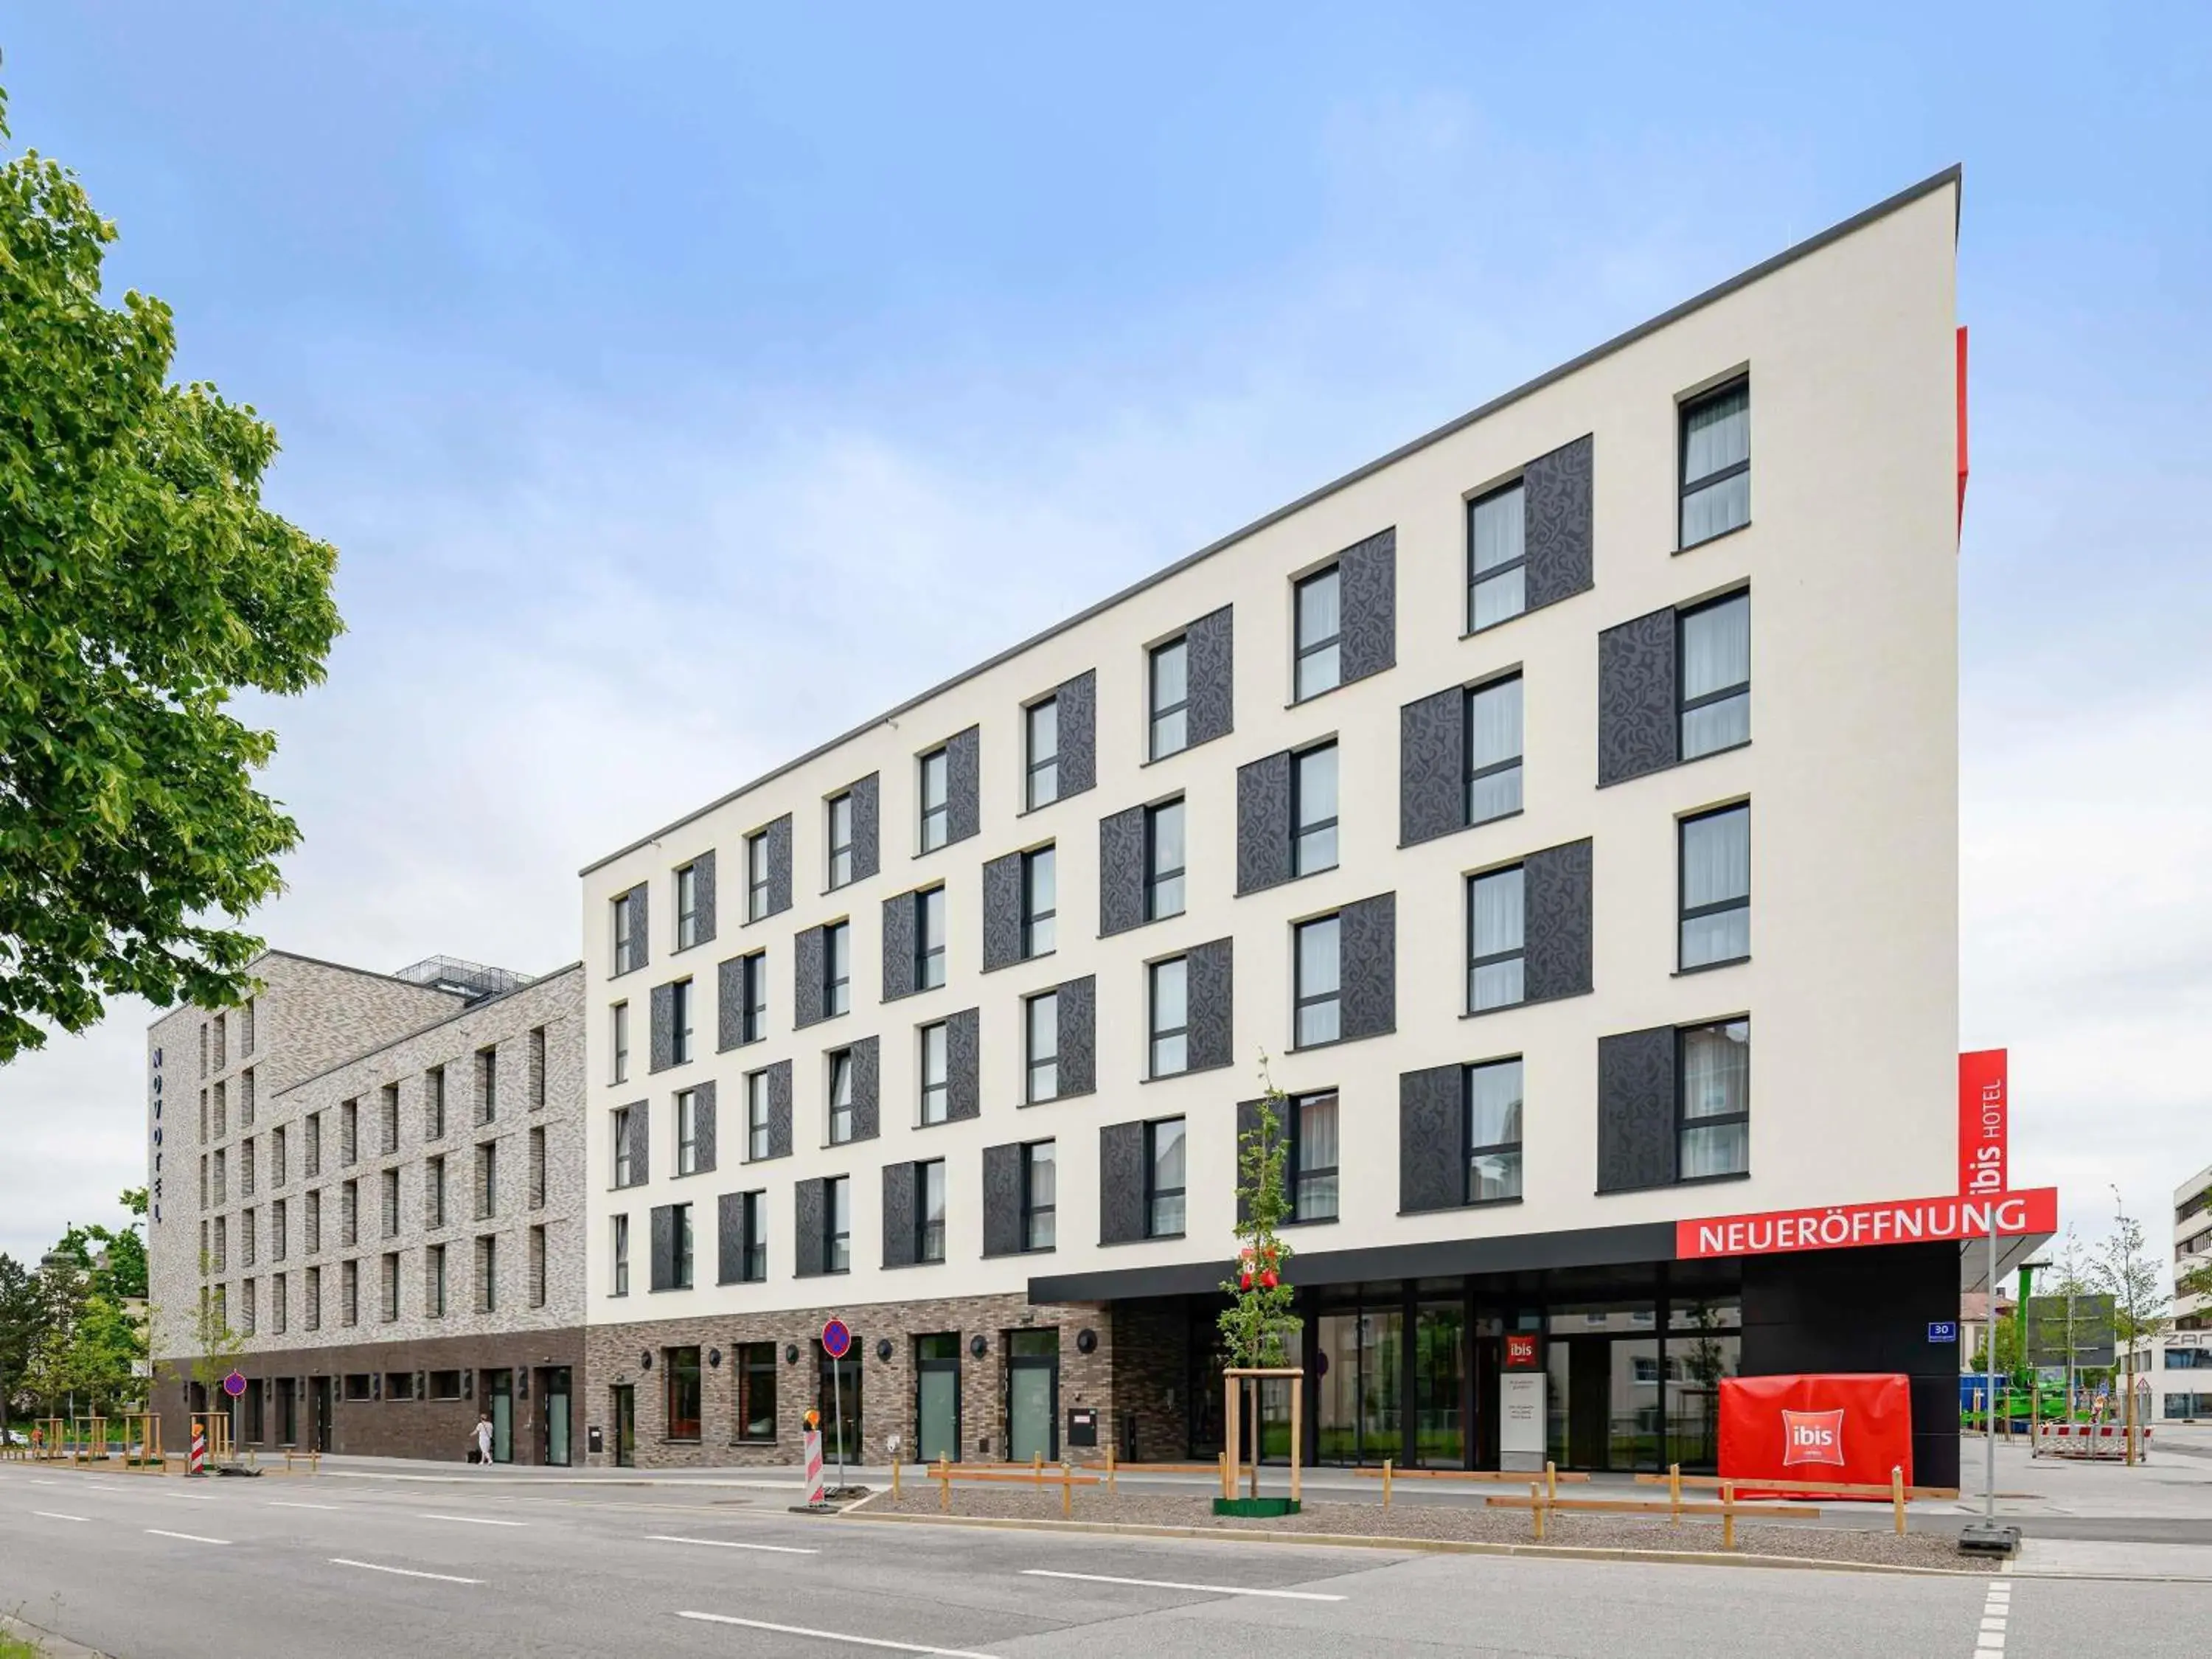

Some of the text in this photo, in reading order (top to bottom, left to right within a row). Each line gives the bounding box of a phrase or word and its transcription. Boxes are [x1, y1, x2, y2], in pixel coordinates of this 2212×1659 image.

[1969, 1078, 2001, 1195] ibis HOTEL
[1699, 1198, 2026, 1253] NEUERÖFFNUNG
[1935, 1325, 1949, 1334] 30
[1510, 1342, 1532, 1357] ibis
[1793, 1425, 1833, 1446] ibis
